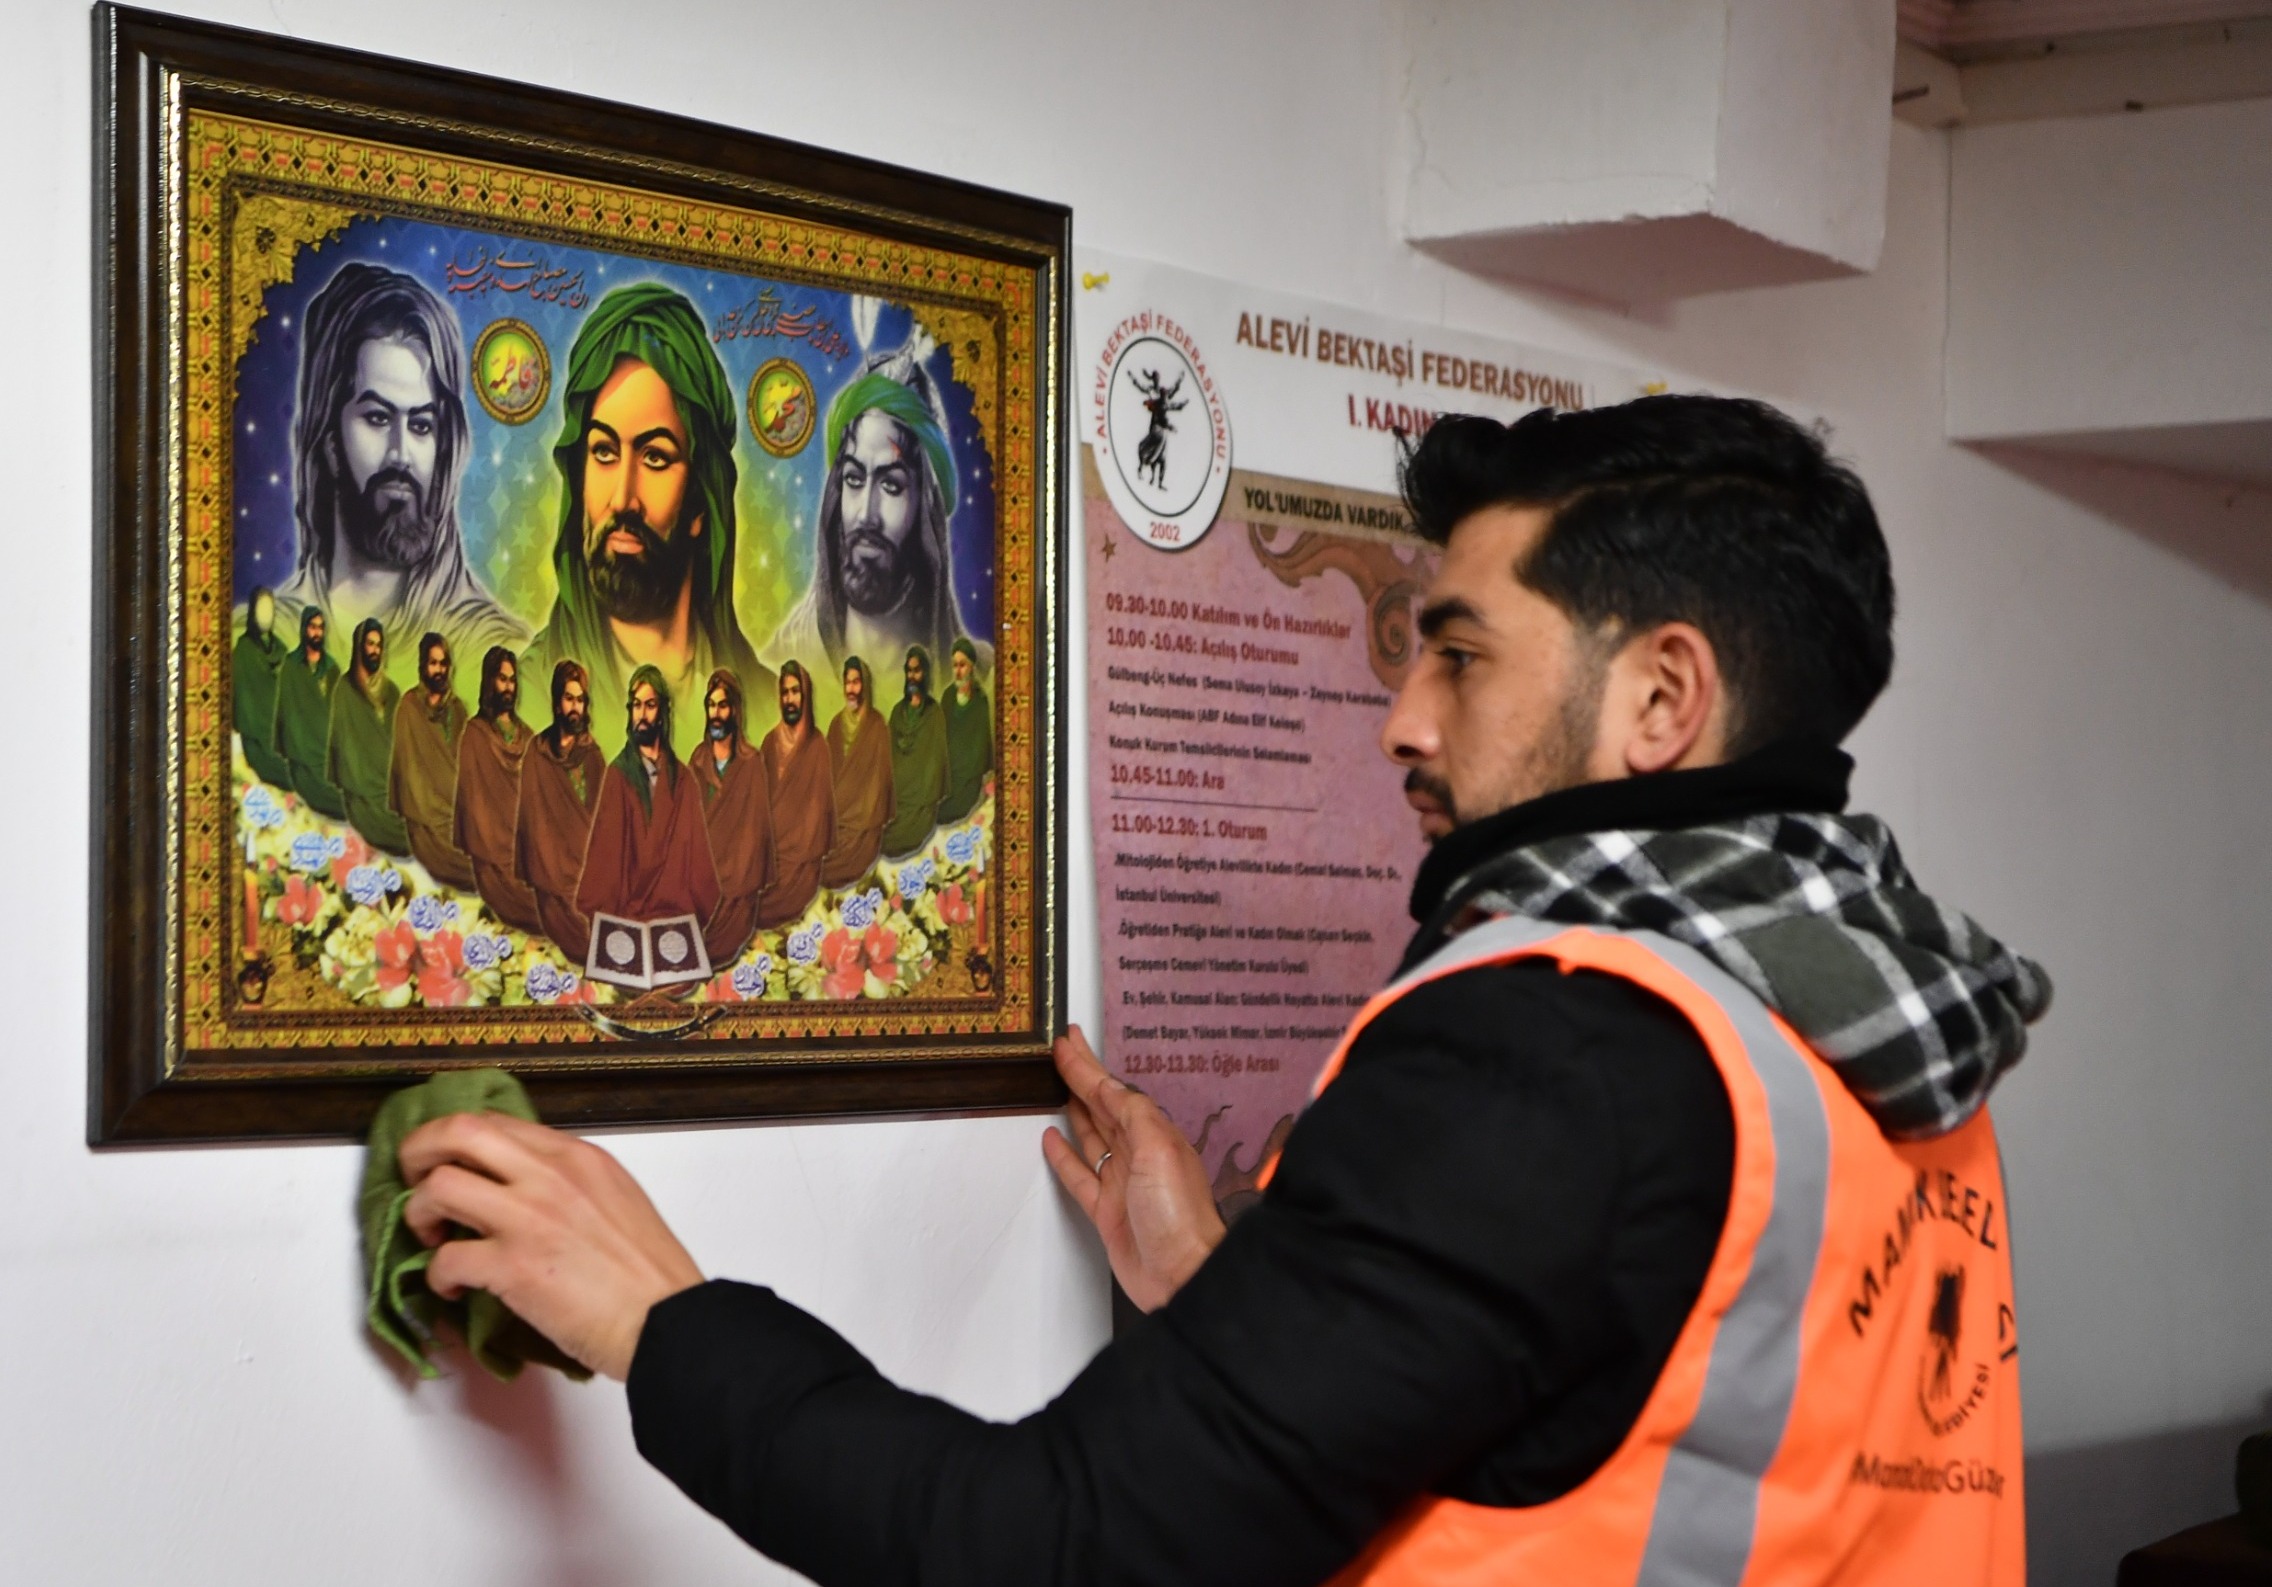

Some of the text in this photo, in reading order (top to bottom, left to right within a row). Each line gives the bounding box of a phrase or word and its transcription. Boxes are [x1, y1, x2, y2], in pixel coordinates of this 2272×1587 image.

[1236, 311, 1584, 412] ALEVİ BEKTAŞİ FEDERASYONU
[1094, 308, 1226, 460] ALEVİ BEKTAŞİ FEDERASYONU
[1244, 486, 1343, 523] YOL'UMUZDA
[1150, 520, 1181, 542] 2002
[1106, 592, 1188, 620] 09.30-10.00
[1192, 603, 1241, 627] Katılım
[1244, 614, 1259, 629] ve
[1263, 606, 1281, 631] Ön
[1107, 626, 1146, 649] 10.00
[1201, 637, 1238, 664] Açılış
[1241, 642, 1299, 666] Oturumu
[1110, 764, 1226, 790] 10.45-11.00: Ara
[1111, 813, 1267, 841] 11.00-12.30: 1. Oturum
[1212, 1050, 1242, 1078] Öğle
[1245, 1053, 1280, 1073] Arası
